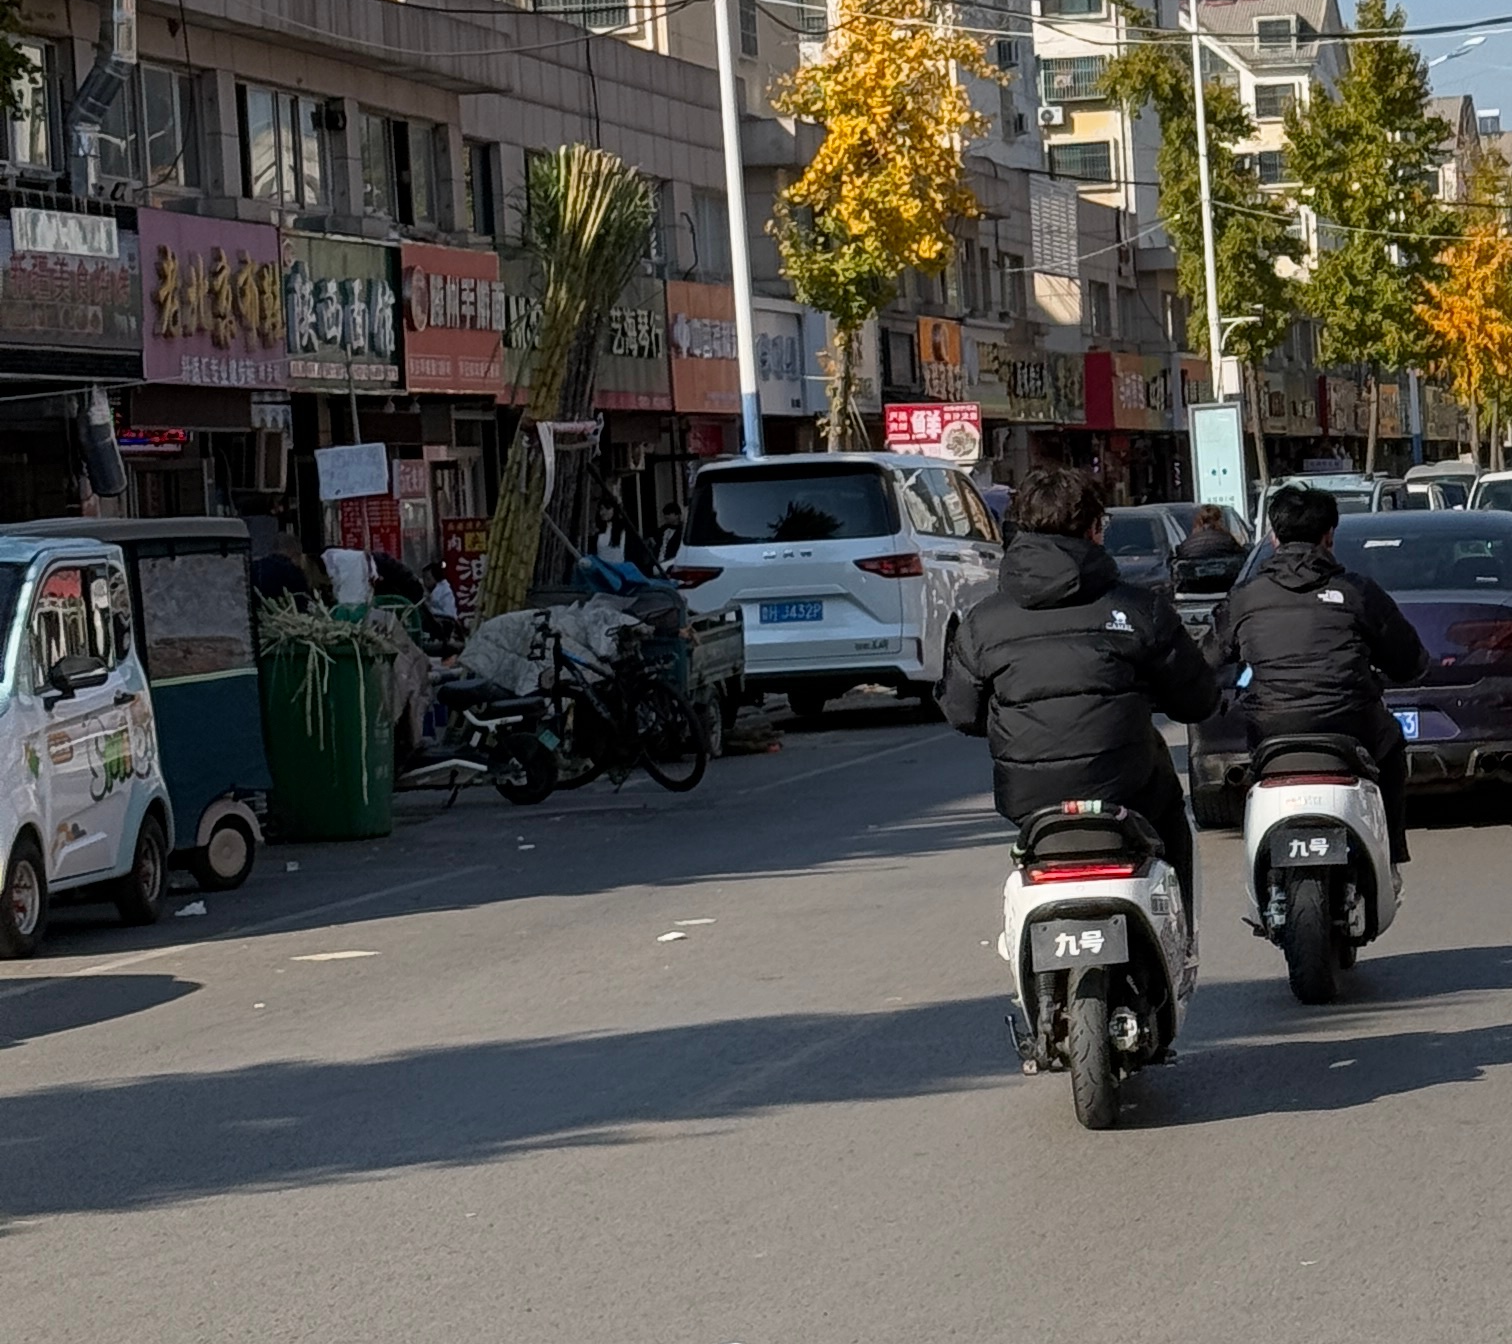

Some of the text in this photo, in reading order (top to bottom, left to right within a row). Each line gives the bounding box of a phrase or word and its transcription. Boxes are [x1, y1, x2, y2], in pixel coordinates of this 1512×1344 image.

[910, 410, 942, 440] 鲜
[1288, 837, 1330, 858] 九号
[1054, 929, 1105, 958] 九号
